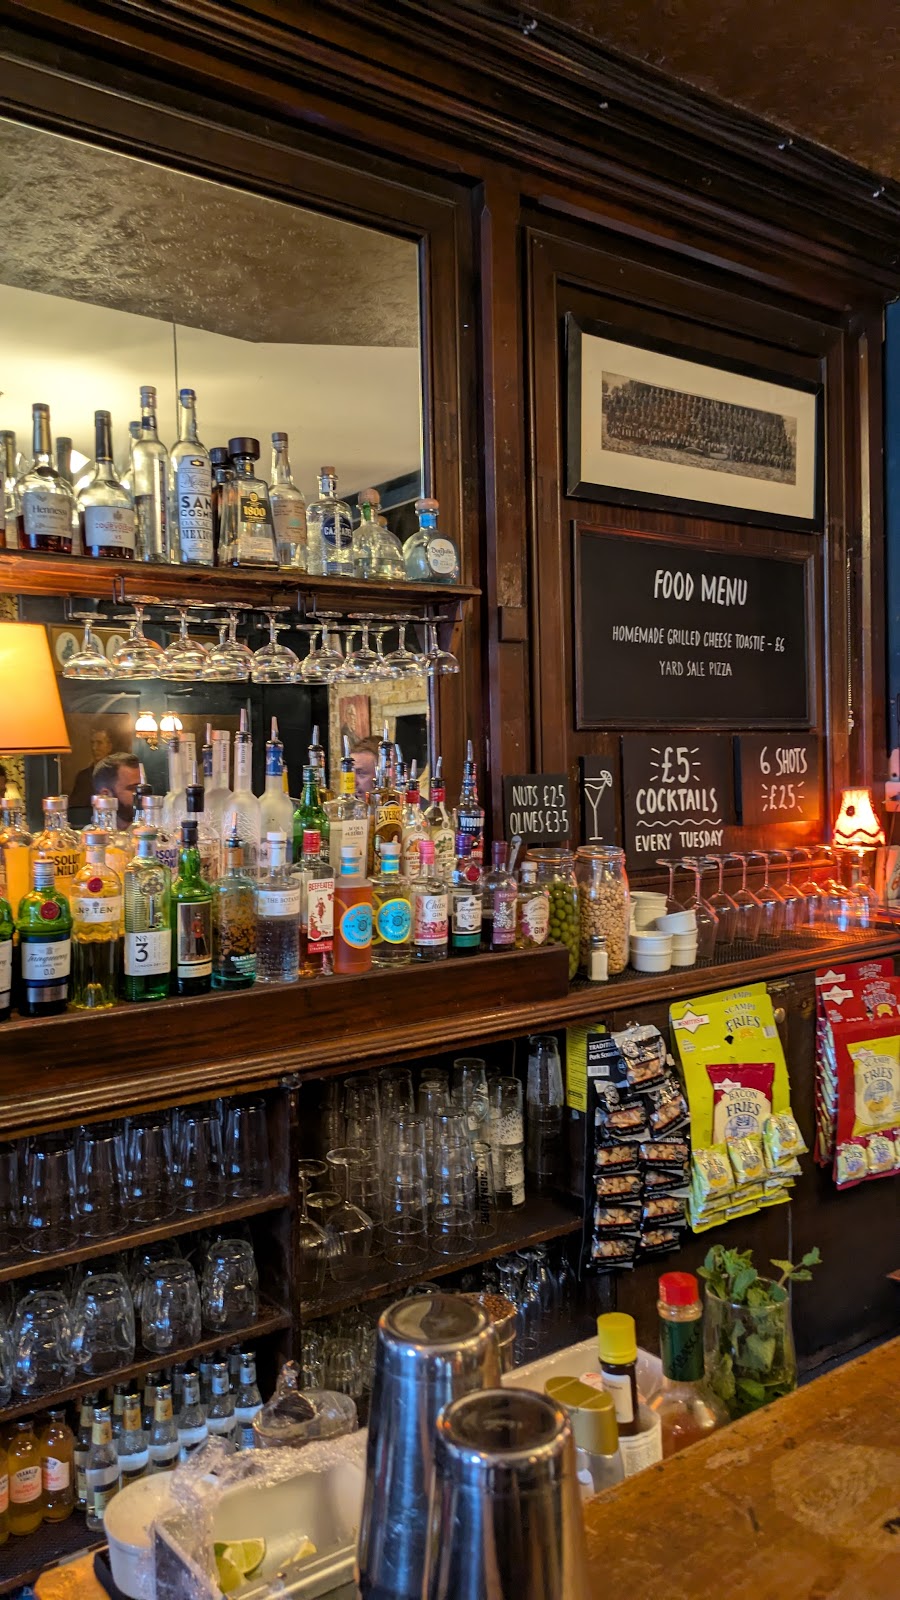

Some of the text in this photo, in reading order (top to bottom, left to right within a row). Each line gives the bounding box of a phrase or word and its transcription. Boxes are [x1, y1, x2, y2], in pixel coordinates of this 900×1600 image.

[243, 506, 267, 517] 1800
[653, 569, 748, 606] FOOD MENU
[612, 625, 664, 645] HOMEMADE
[667, 628, 700, 647] GRILLED
[703, 632, 732, 649] CHEESE
[735, 634, 765, 651] TOASTIE
[774, 637, 785, 652] £6
[659, 660, 733, 677] YARD SALE PIZZA
[661, 746, 690, 783] £5
[759, 746, 808, 776] 6 SHOTS
[512, 785, 539, 807] NUTS
[636, 787, 719, 815] COCKTAILS
[769, 784, 796, 809] £25
[510, 810, 544, 835] OLIVES
[635, 829, 724, 852] EVERY TUESDAY
[308, 881, 334, 892] BEEFEATER
[135, 942, 149, 963] 3
[725, 1015, 761, 1034] FRIES
[863, 1068, 894, 1084] FRIES
[729, 1090, 758, 1101] BACON
[725, 1101, 762, 1117] FRIES
[480, 1170, 490, 1226] SIGNATURE
